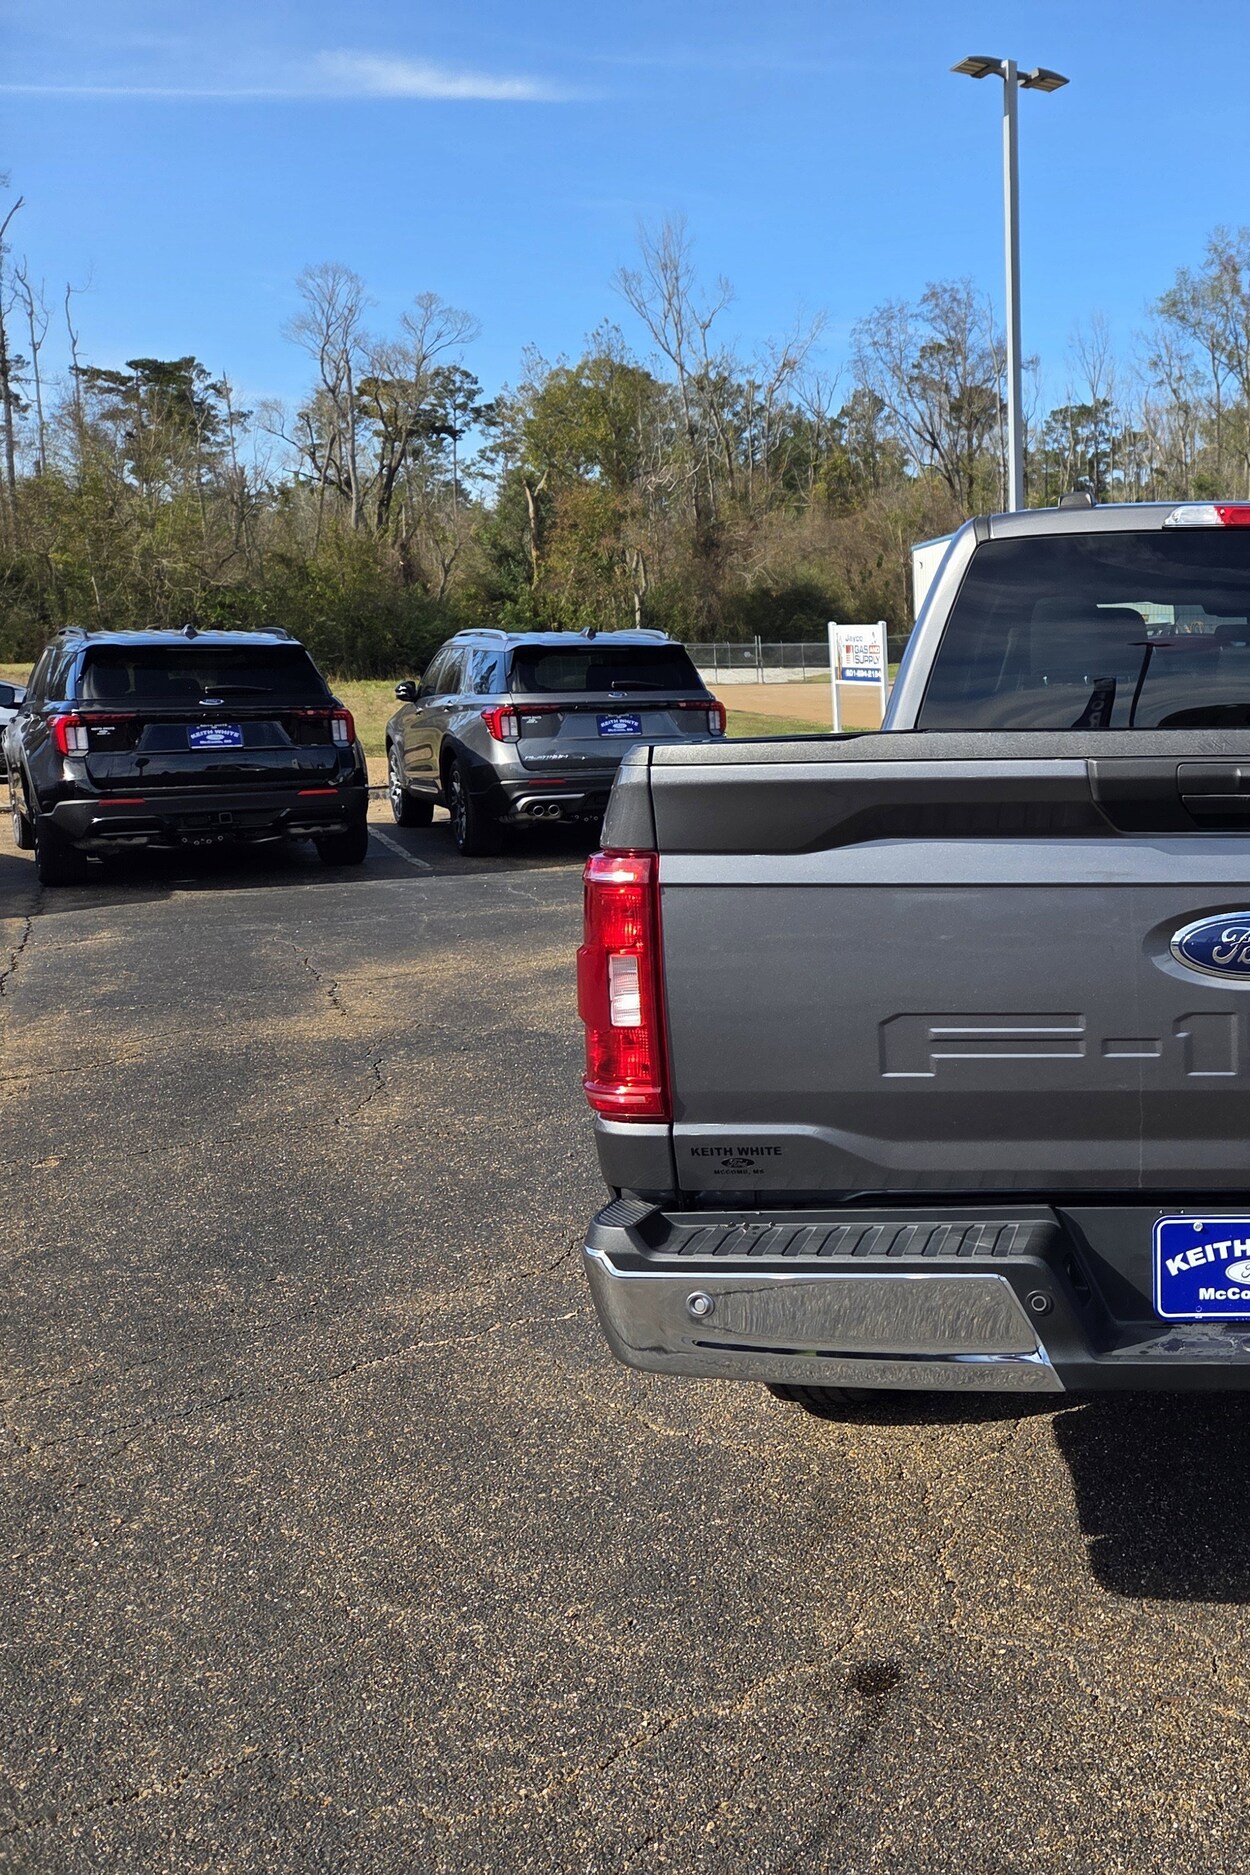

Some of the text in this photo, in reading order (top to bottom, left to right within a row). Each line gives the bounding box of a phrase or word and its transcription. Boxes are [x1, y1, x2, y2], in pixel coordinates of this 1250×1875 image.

[855, 645, 868, 654] GAS
[855, 655, 880, 664] SUPPLY
[214, 729, 239, 738] WHITE
[690, 1146, 782, 1156] KEITH WHITE
